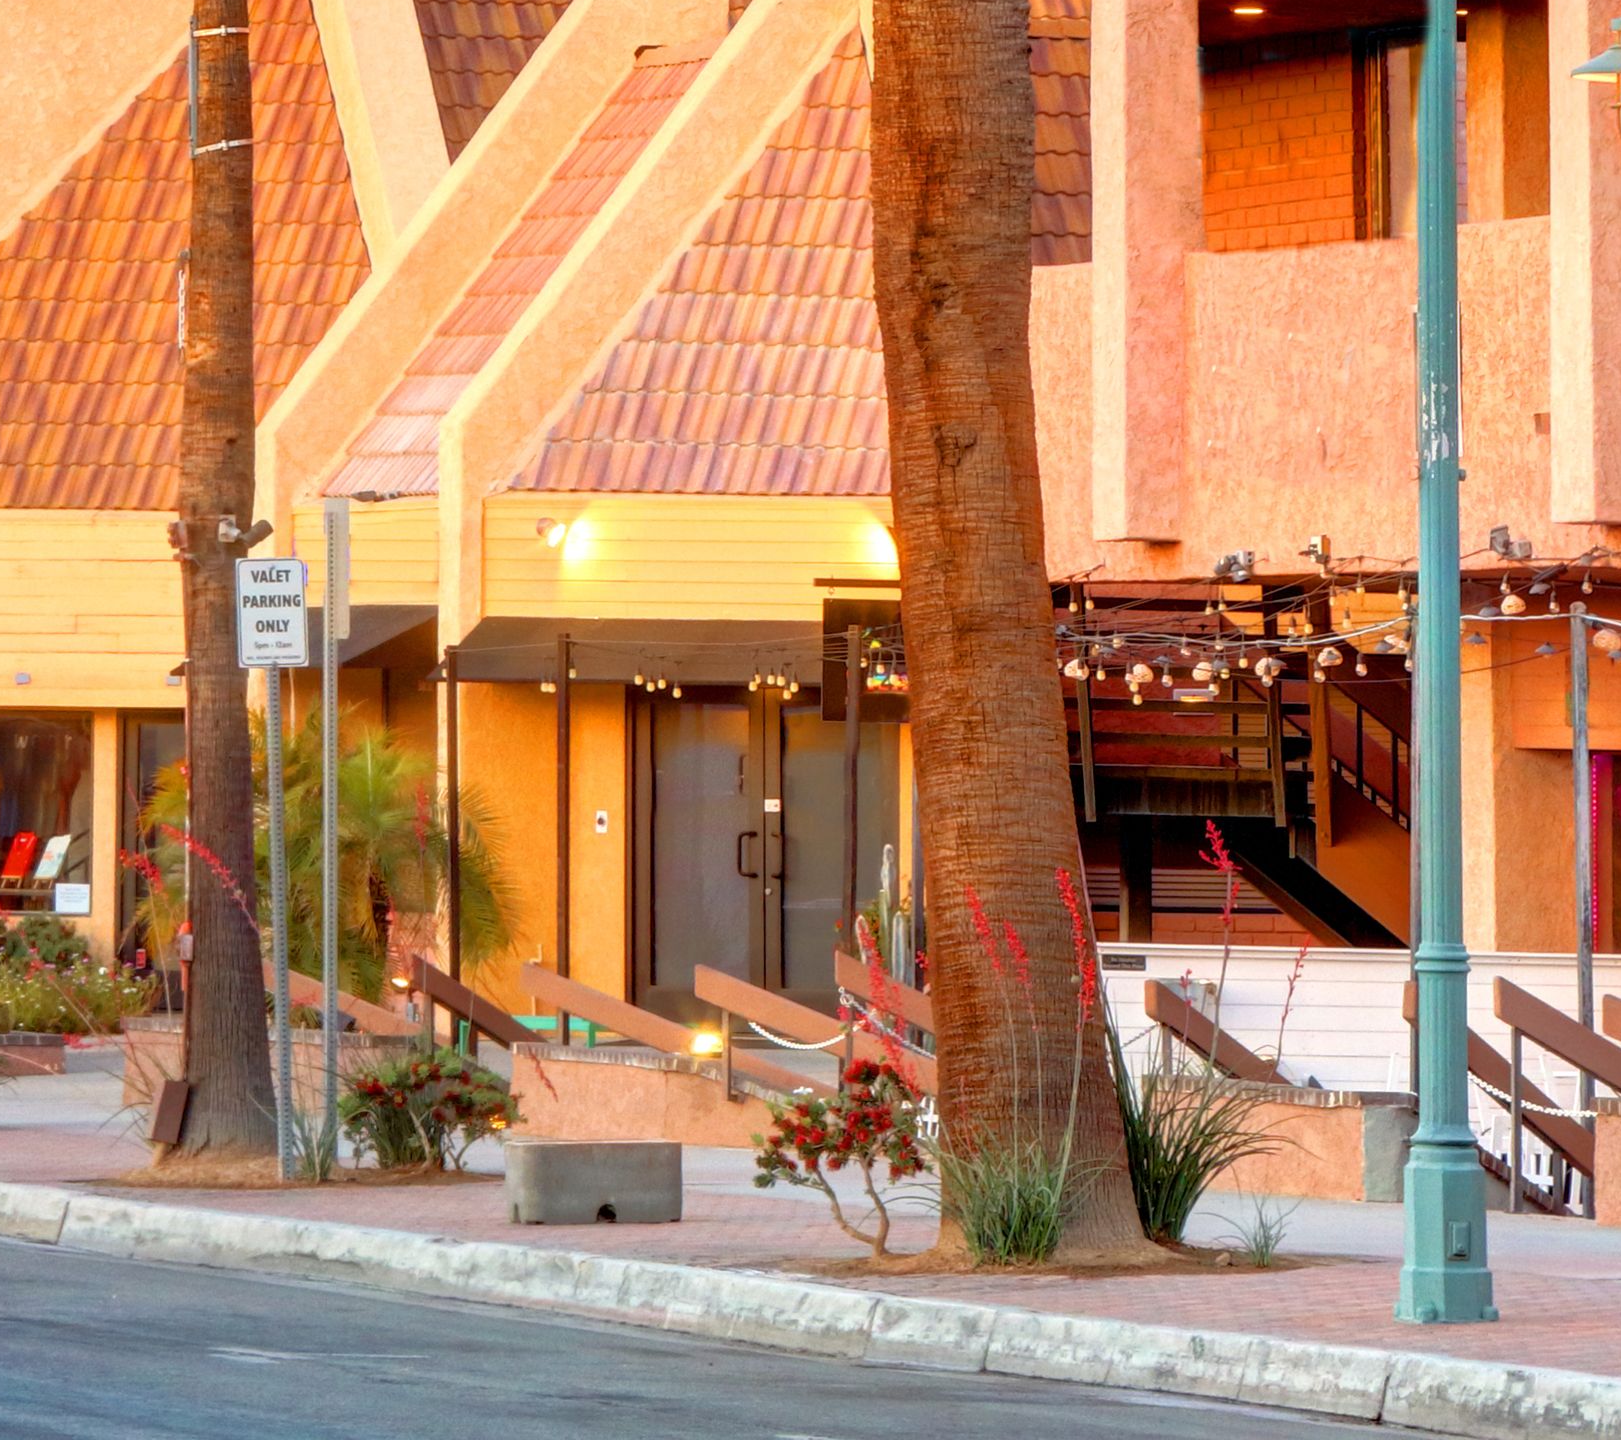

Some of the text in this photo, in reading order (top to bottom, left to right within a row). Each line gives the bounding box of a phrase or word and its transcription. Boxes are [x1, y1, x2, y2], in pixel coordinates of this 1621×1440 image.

[251, 570, 291, 583] VALET
[242, 594, 301, 608] PARKING
[256, 619, 290, 633] ONLY
[254, 642, 269, 651] 5pm
